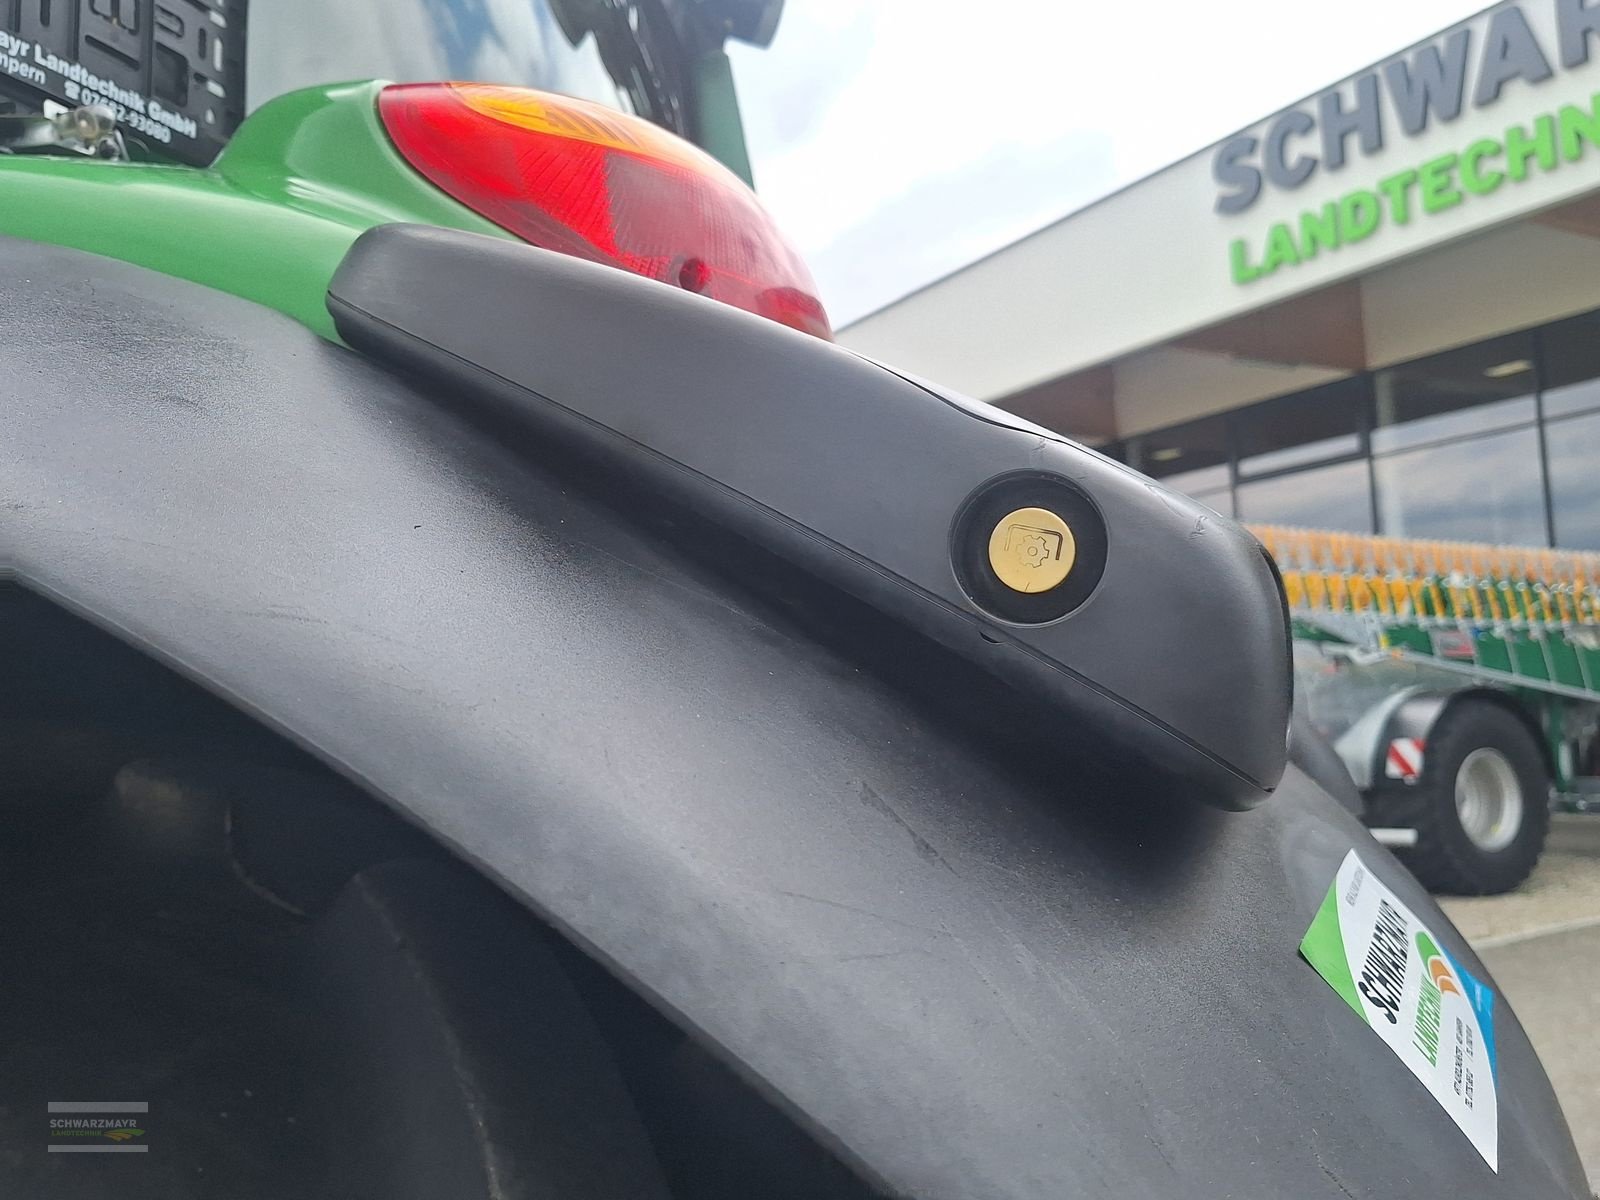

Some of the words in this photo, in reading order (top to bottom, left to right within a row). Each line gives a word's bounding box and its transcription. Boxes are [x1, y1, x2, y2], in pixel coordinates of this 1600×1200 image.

[34, 43, 145, 114] Landtechnik
[148, 100, 197, 139] GmbH
[1358, 898, 1409, 1025] SCHWARZMAYR
